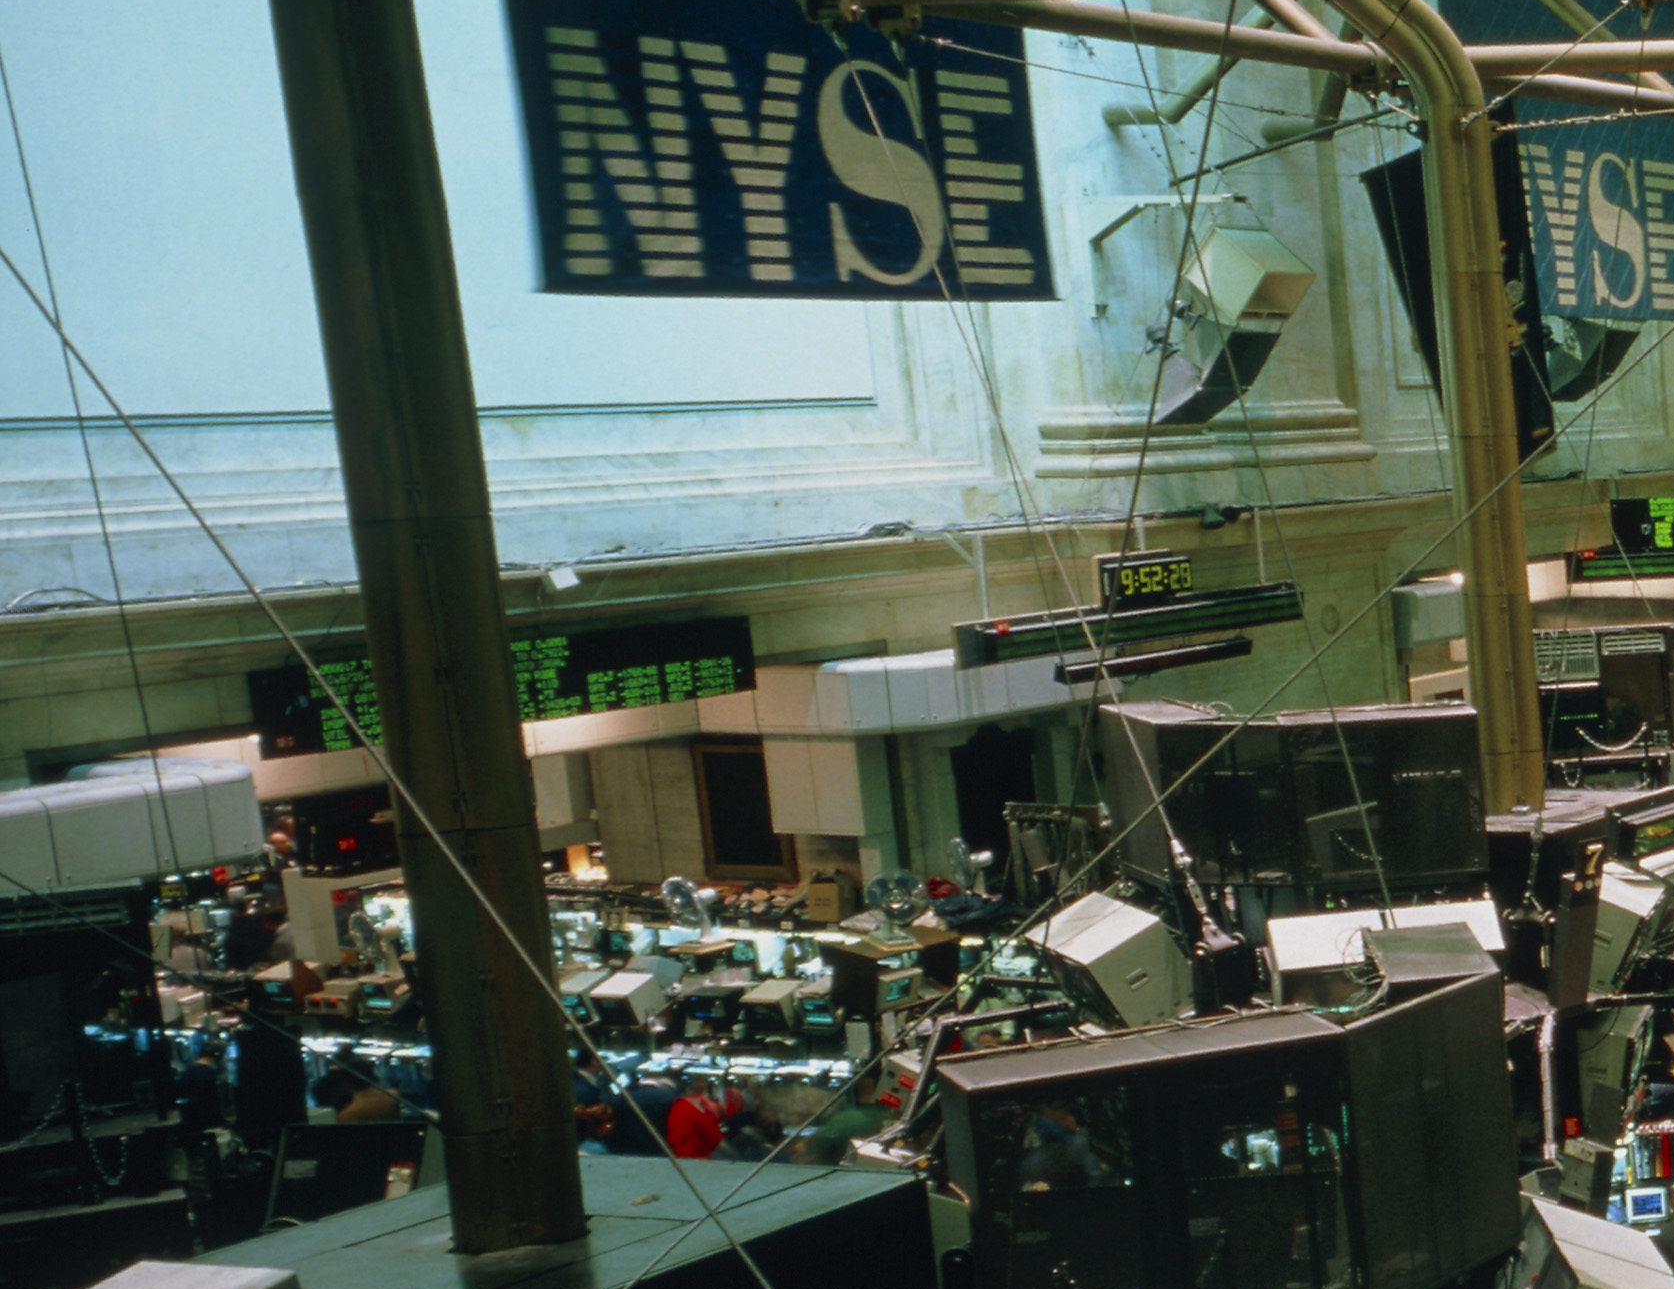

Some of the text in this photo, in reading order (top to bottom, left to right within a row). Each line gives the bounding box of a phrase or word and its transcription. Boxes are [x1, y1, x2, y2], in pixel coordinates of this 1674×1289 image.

[546, 26, 1034, 287] NYSE
[1120, 562, 1191, 595] 9:52:28
[1585, 843, 1604, 875] 7
